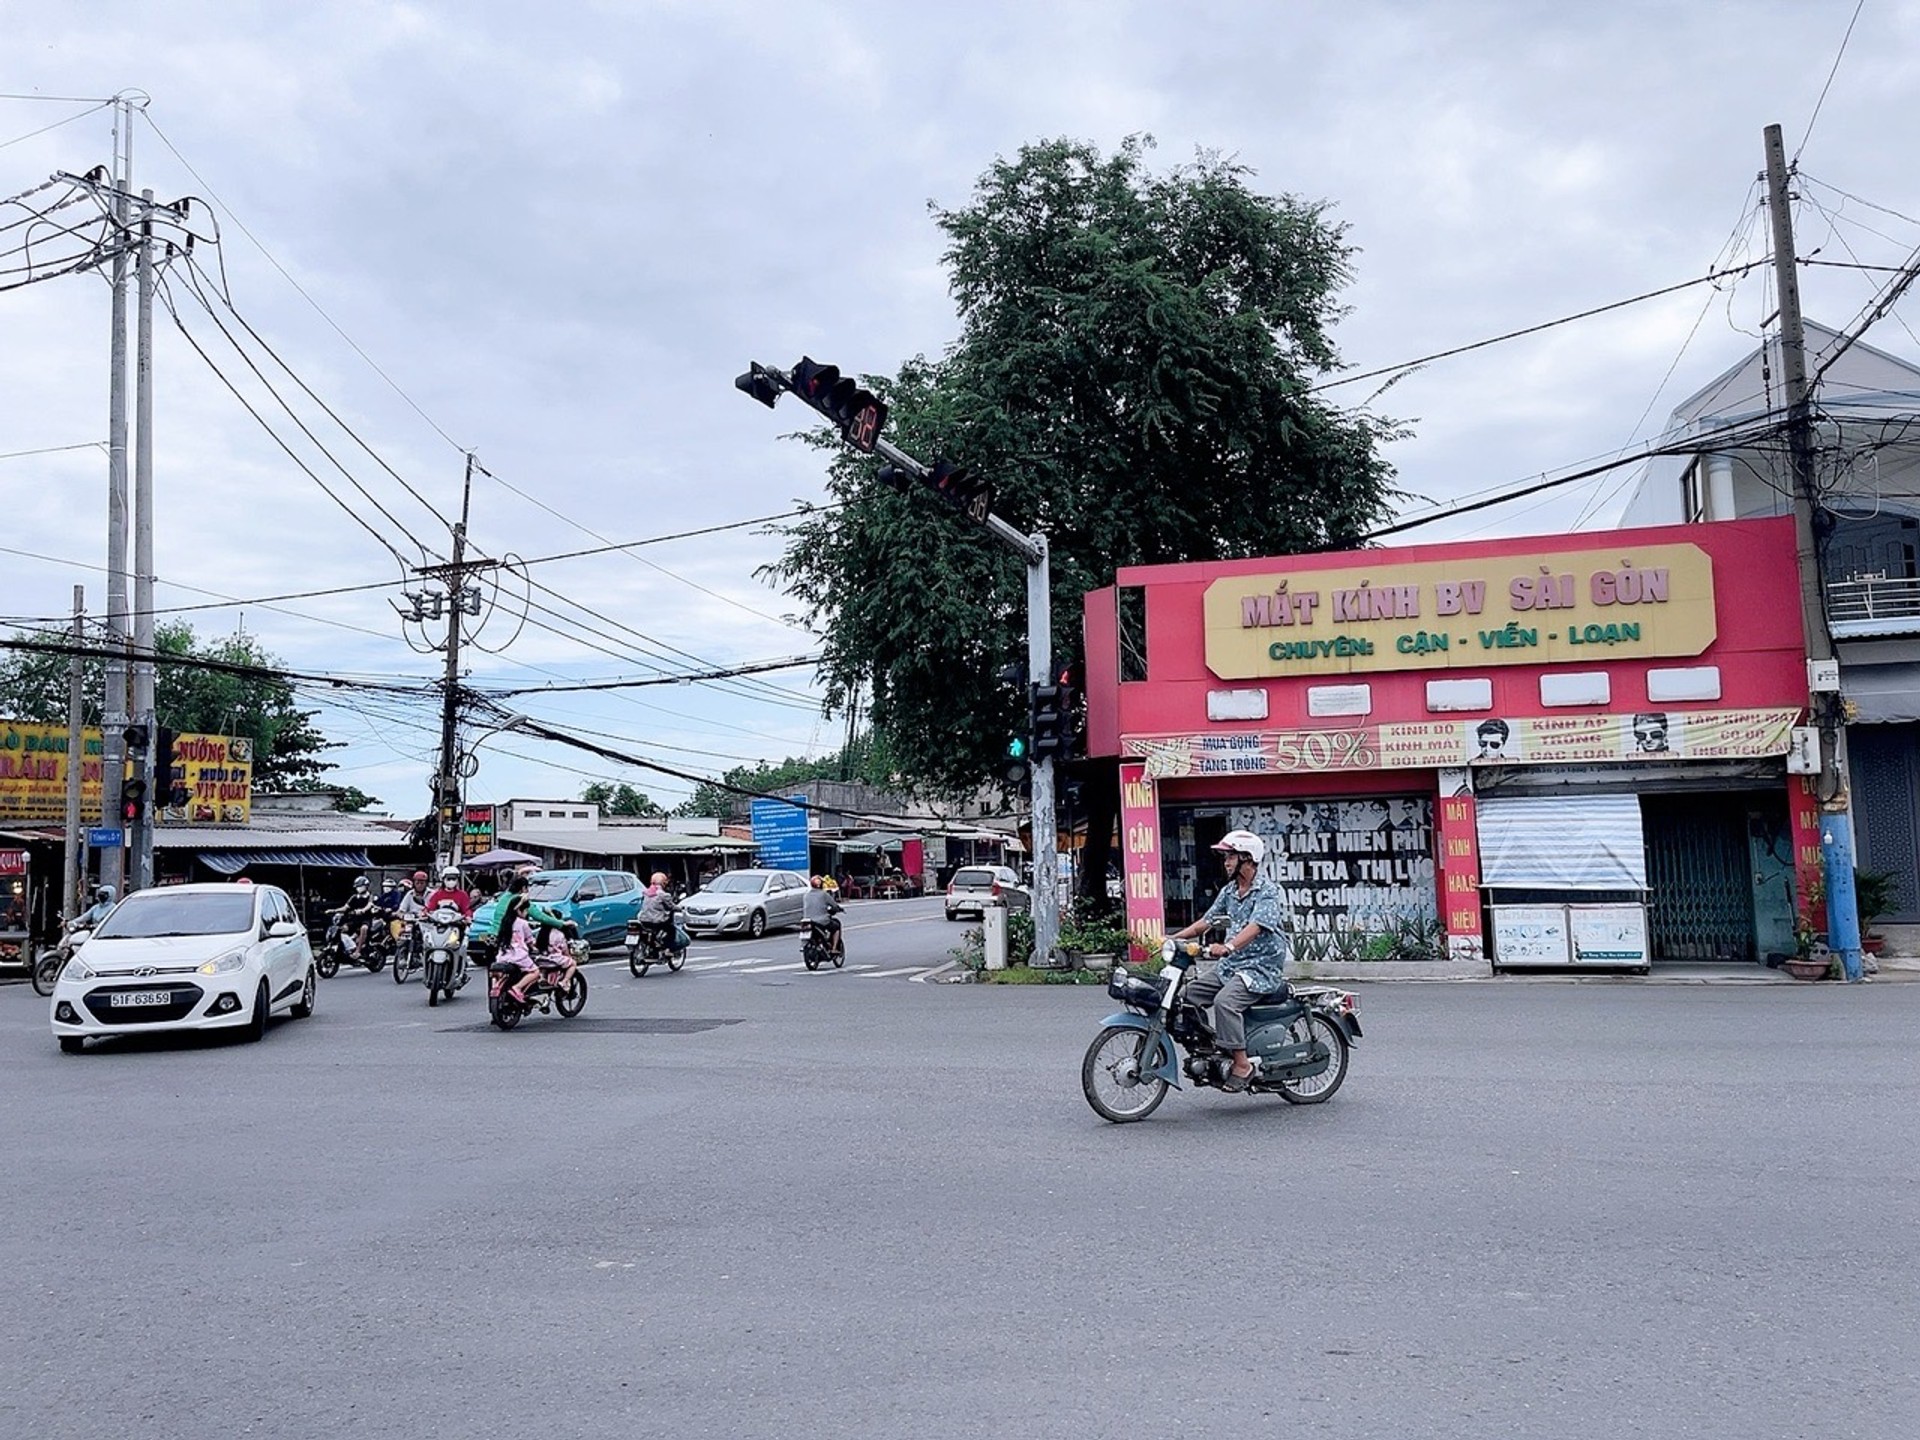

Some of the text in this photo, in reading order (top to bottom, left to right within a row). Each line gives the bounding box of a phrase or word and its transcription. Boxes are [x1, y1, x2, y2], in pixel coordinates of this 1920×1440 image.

[1241, 559, 1670, 629] MẮT KÍNH BV SÀI GÒN
[1396, 630, 1449, 657] CẬN
[1478, 621, 1538, 650] VIỄN
[1569, 622, 1641, 647] LOẠN
[1275, 730, 1376, 770] 50%
[1309, 860, 1349, 880] TRA
